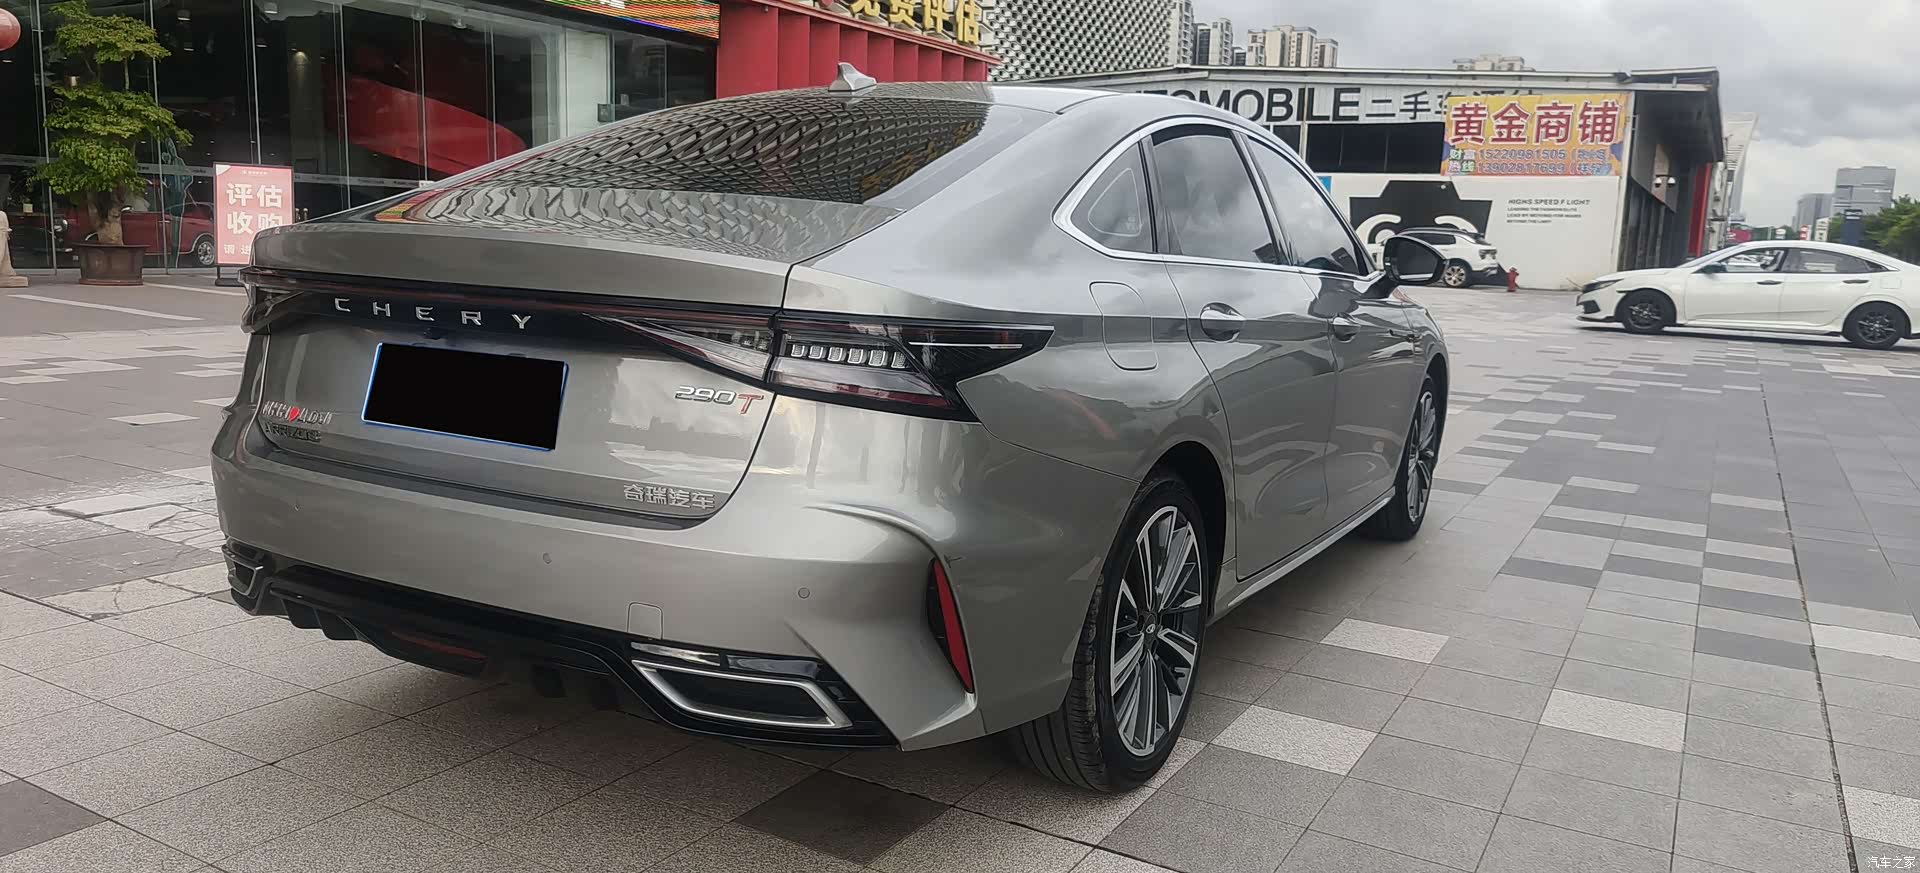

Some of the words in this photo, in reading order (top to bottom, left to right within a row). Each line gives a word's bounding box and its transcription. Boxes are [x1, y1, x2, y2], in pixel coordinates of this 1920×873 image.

[1450, 100, 1621, 145] 黄金商铺
[226, 183, 284, 209] 评估
[334, 298, 532, 330] CHERY
[675, 385, 764, 415] 290T
[623, 483, 715, 510] 奇瑞汽车
